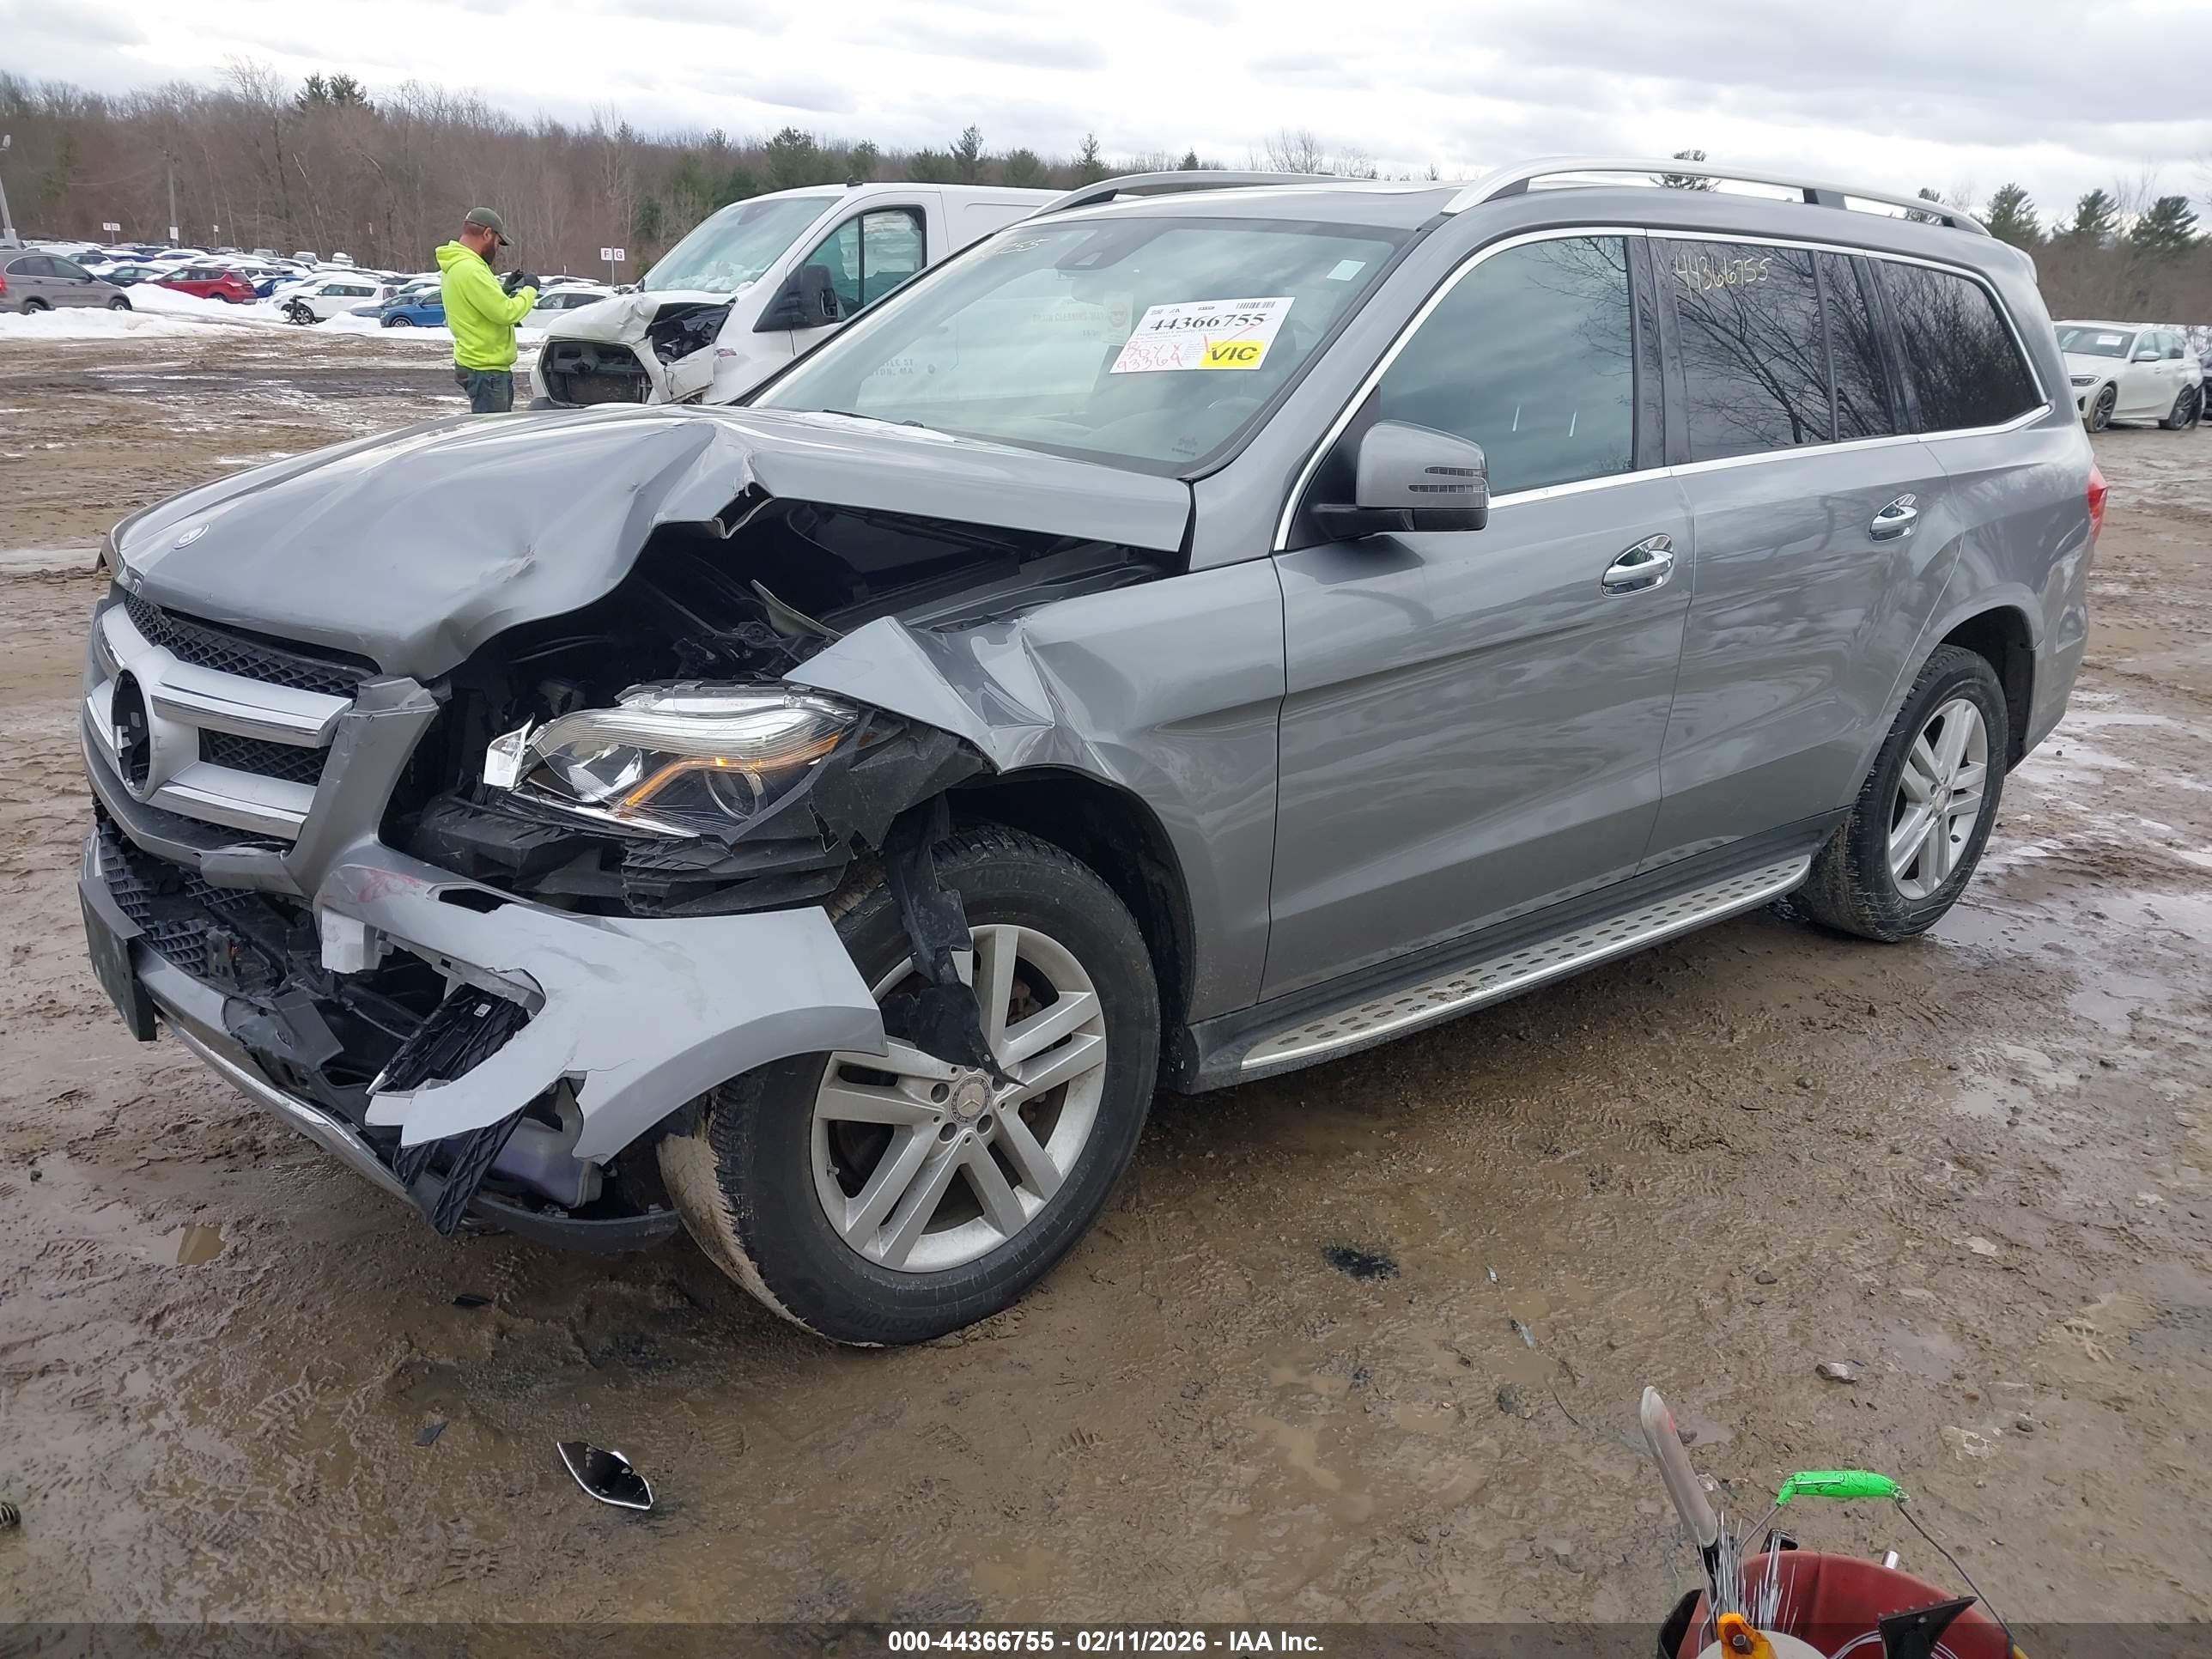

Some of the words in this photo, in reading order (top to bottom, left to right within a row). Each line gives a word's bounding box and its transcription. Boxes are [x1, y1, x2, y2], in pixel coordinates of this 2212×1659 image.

[1674, 252, 1774, 302] 44366755
[1150, 313, 1267, 331] 44366755
[1211, 347, 1257, 361] VIC
